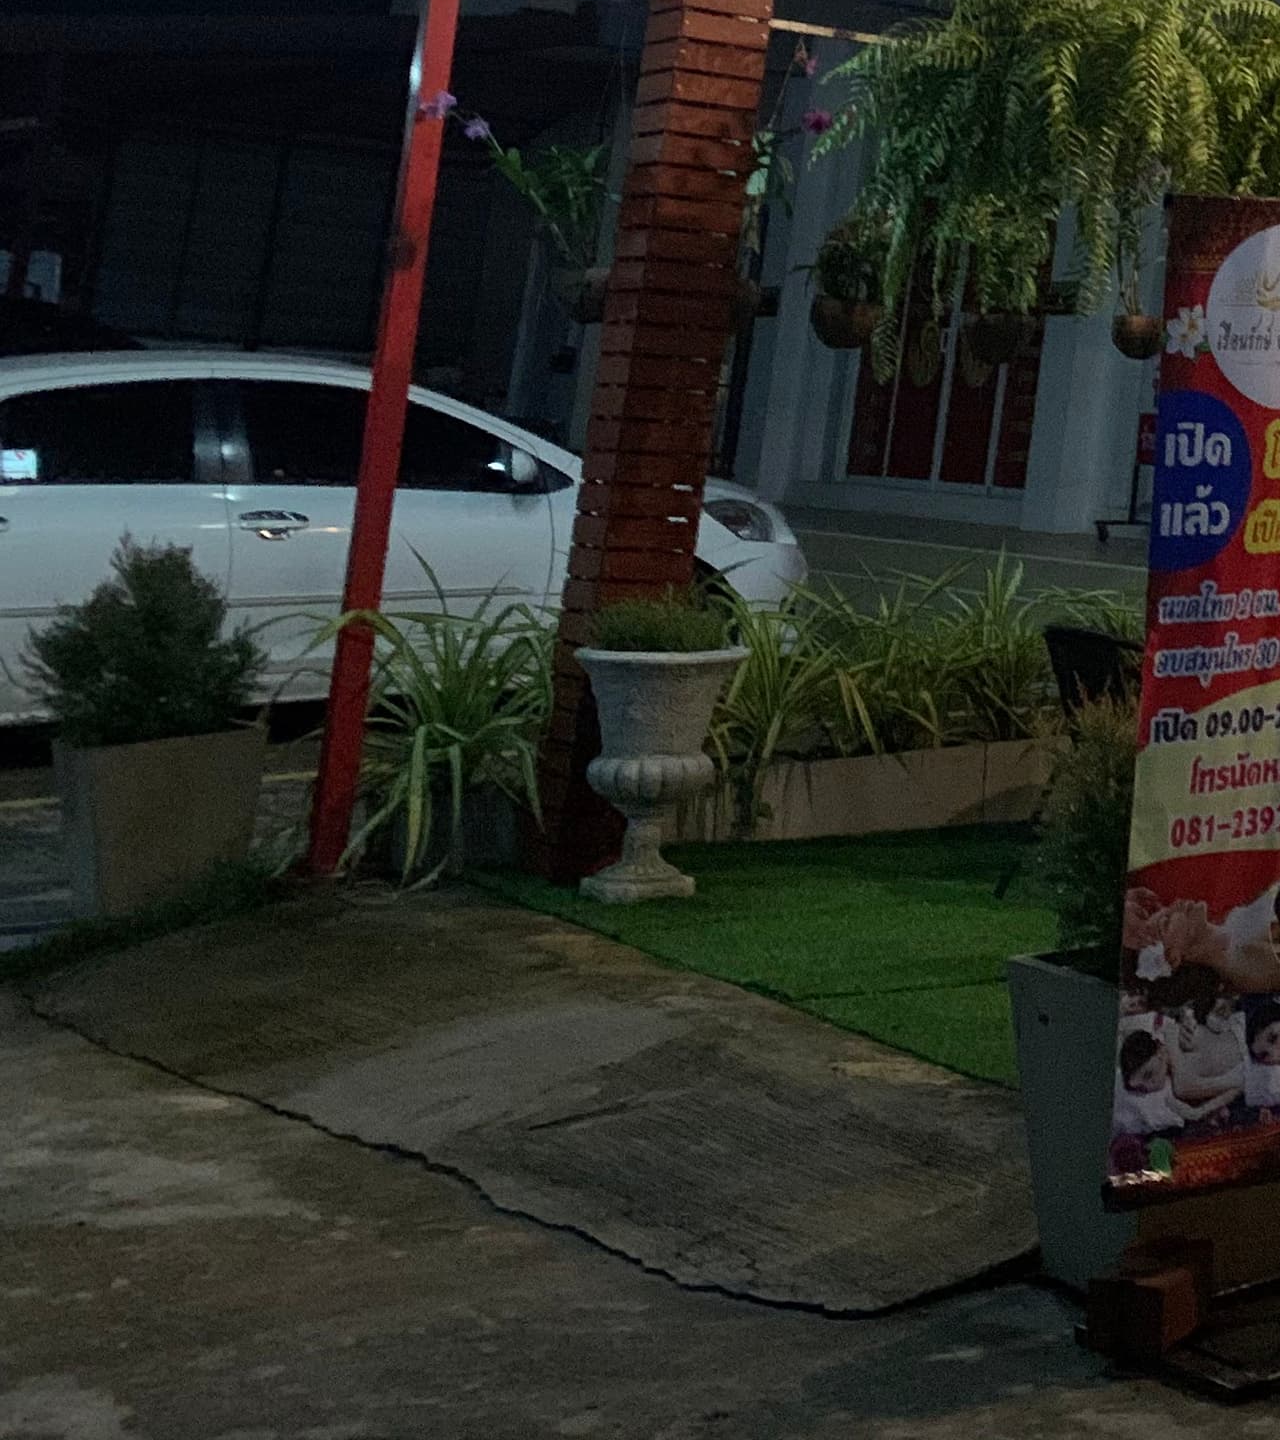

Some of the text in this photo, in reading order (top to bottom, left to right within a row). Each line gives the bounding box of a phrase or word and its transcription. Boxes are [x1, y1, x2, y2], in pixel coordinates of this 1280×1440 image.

[1164, 422, 1232, 468] เปิด
[1159, 483, 1231, 537] แล้ว
[1255, 639, 1278, 667] 30
[1153, 712, 1198, 743] เปิด
